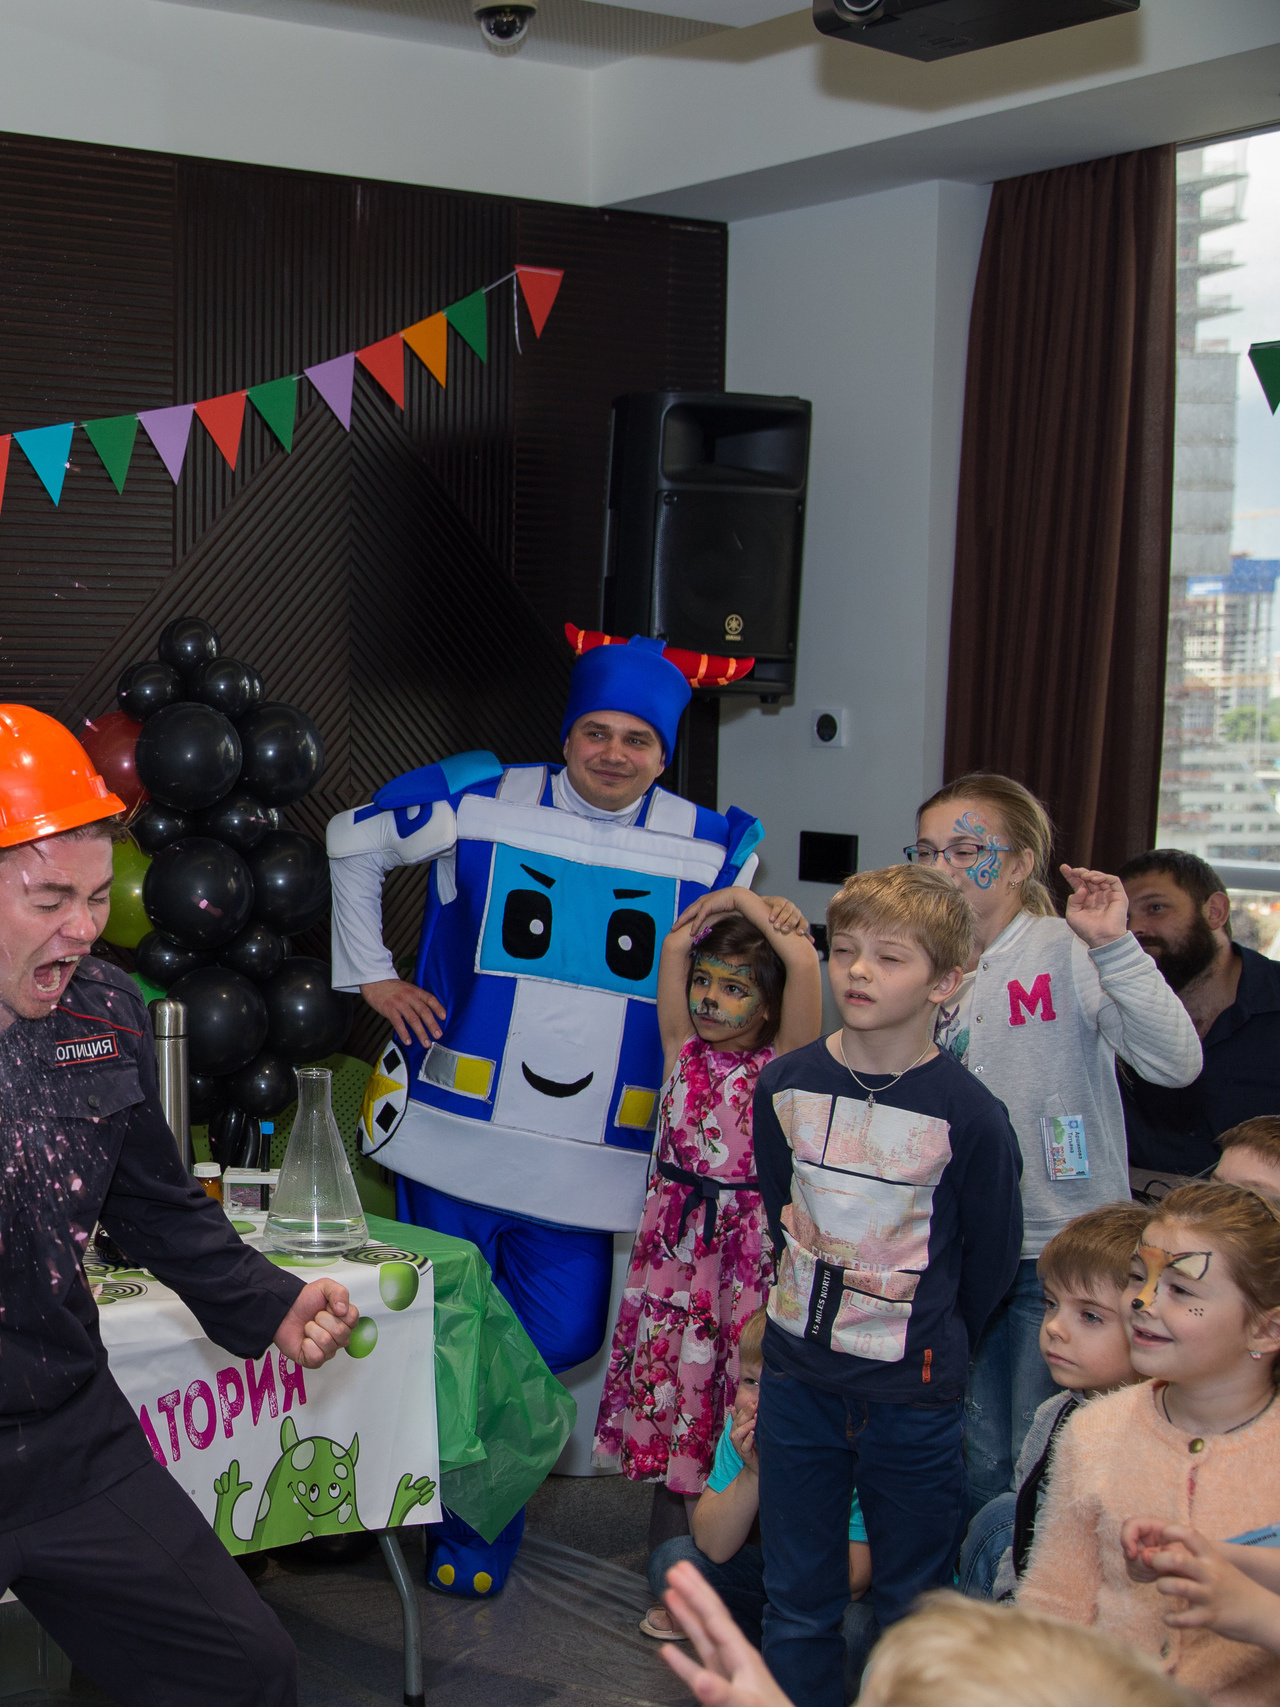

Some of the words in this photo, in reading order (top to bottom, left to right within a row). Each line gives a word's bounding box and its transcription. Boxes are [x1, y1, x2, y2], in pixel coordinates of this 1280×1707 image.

[1006, 972, 1057, 1027] M
[55, 1039, 114, 1061] ОЛИЦИЯ
[820, 1269, 831, 1299] NORTH
[814, 1299, 826, 1324] MILES
[811, 1324, 820, 1335] 15
[852, 1330, 886, 1358] 183
